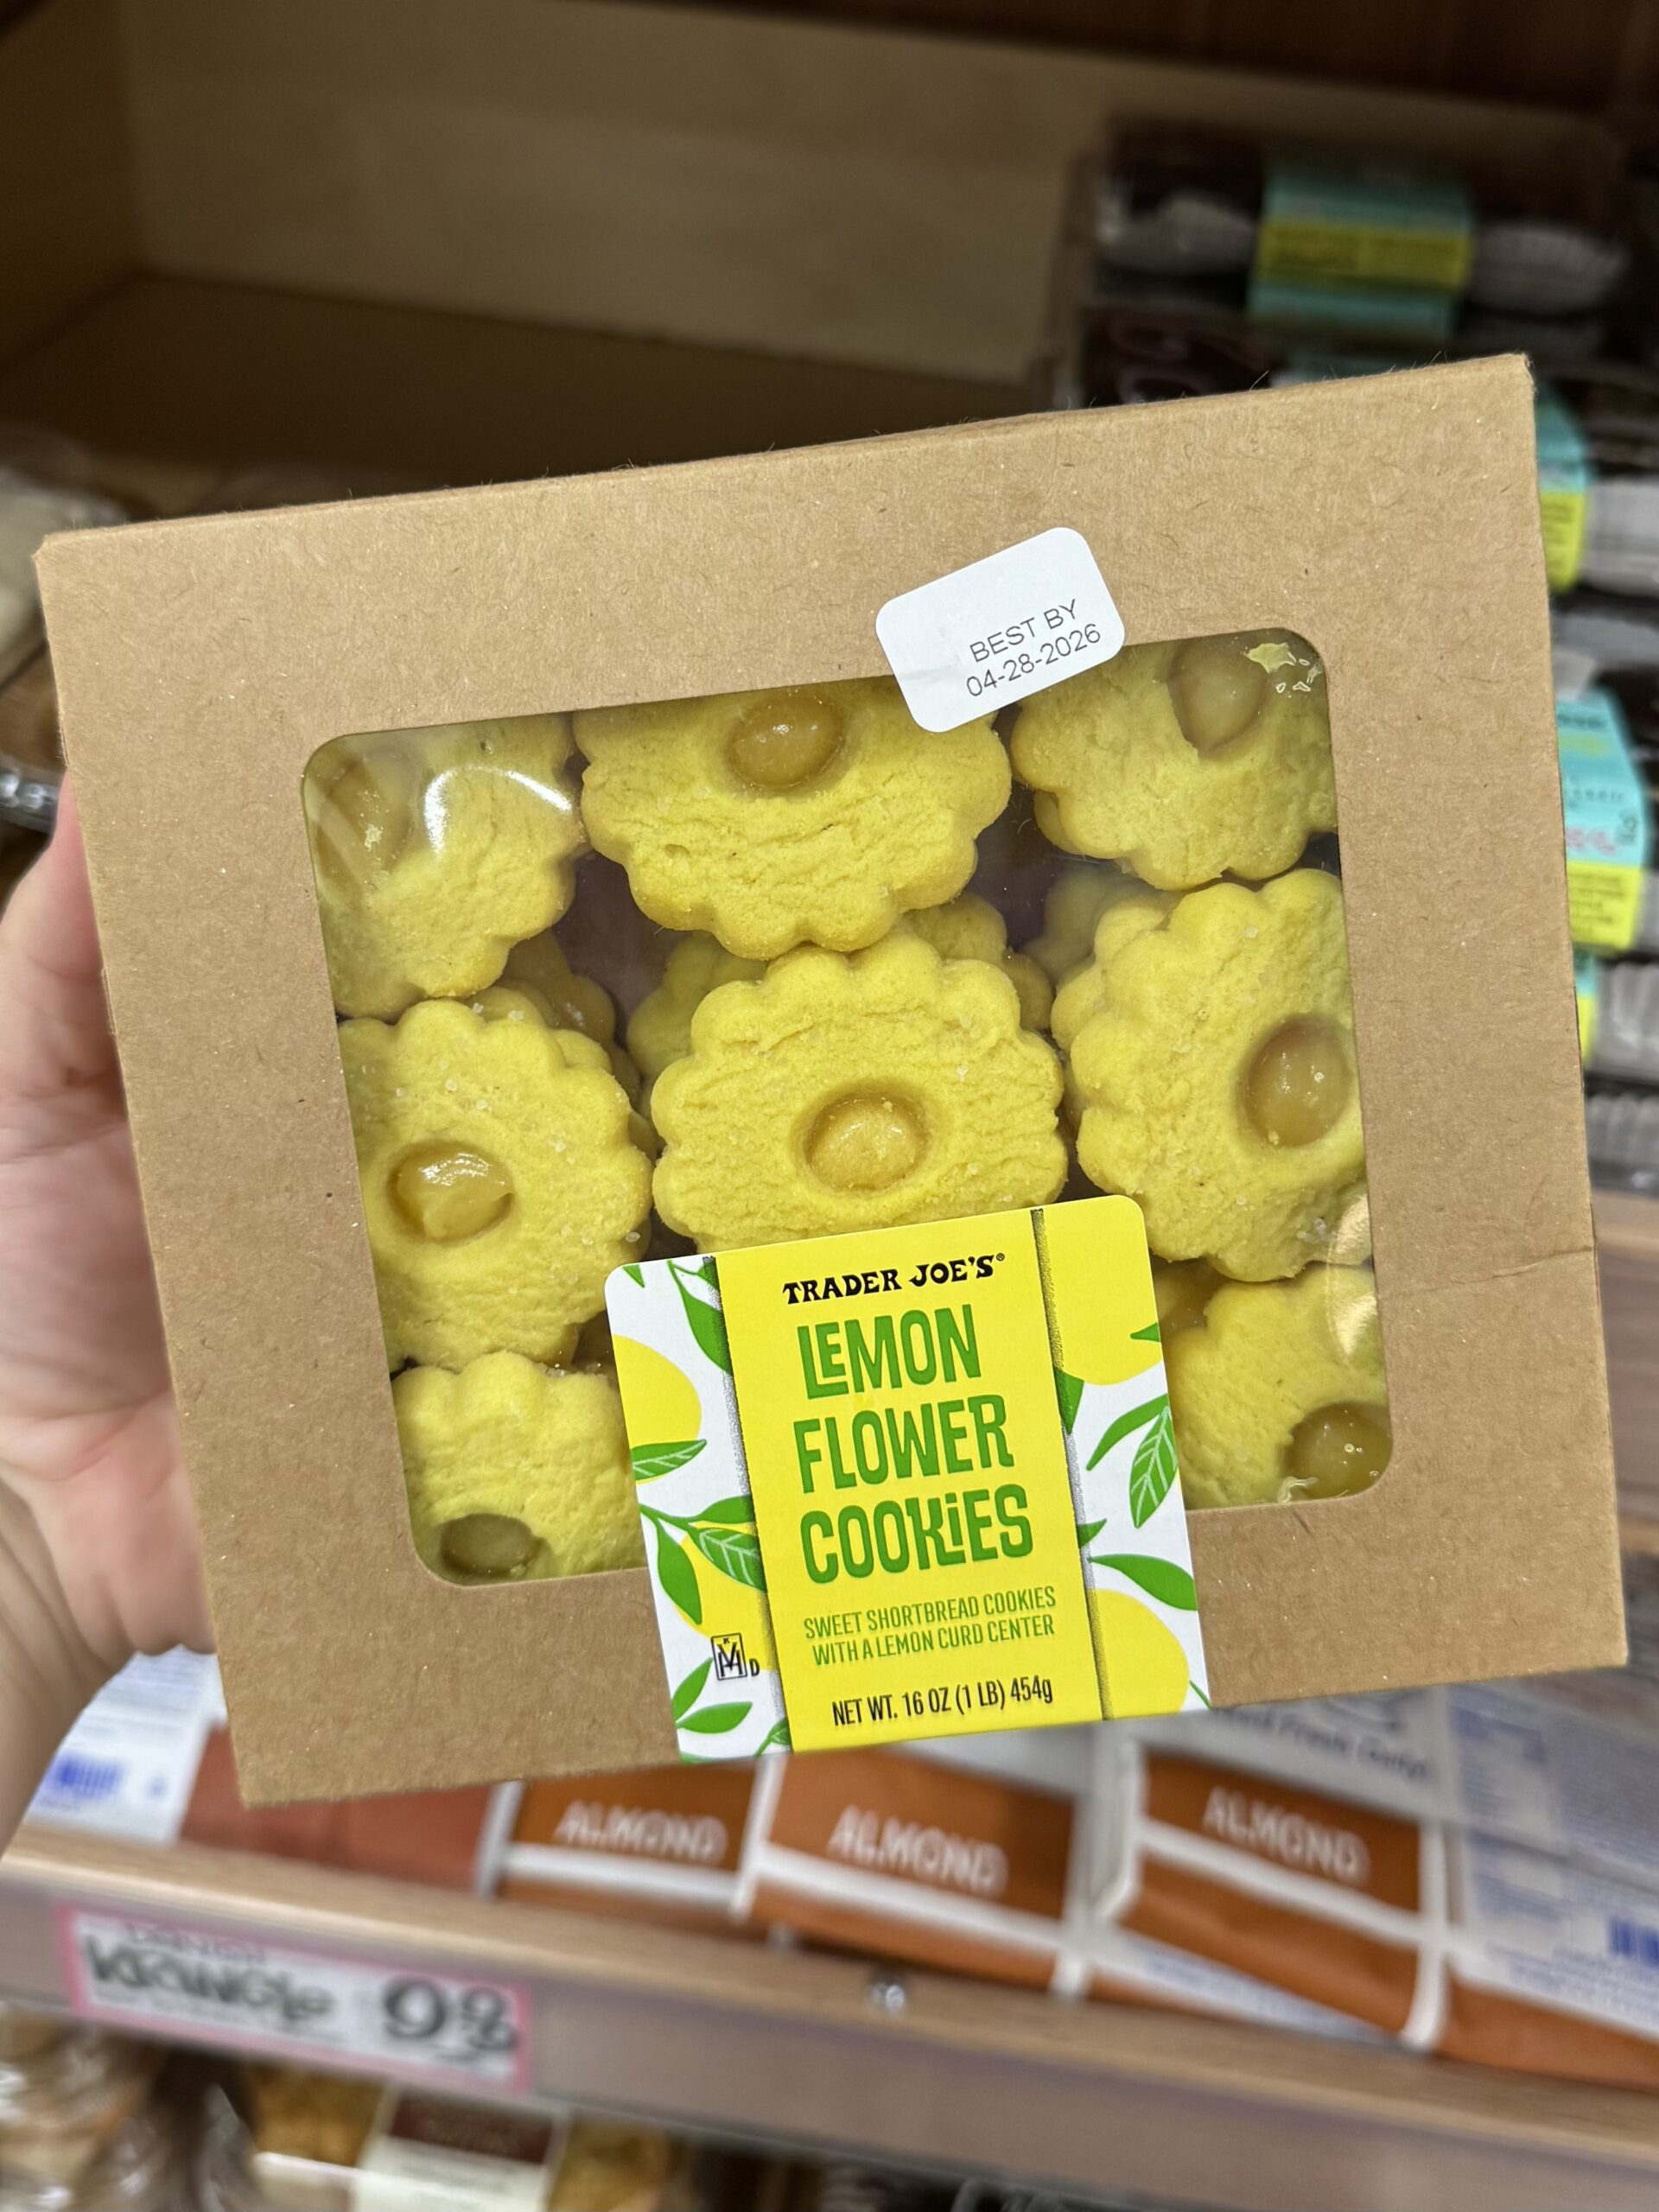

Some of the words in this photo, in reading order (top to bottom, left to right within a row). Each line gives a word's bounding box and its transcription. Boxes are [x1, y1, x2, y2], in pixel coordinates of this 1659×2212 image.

[966, 623, 1101, 696] 04-28-2026
[969, 617, 1036, 663] BEST
[1043, 598, 1078, 630] BY
[782, 1268, 902, 1305] TRADER
[797, 1303, 982, 1400] LEMON
[793, 1394, 1015, 1494] FLOWER
[804, 1611, 862, 1639] SWEET
[866, 1595, 980, 1631] SHORTBREAD
[982, 1586, 1057, 1617] COOKIES
[812, 1639, 859, 1666] WITH
[862, 1637, 874, 1660] A
[877, 1630, 935, 1658] LEMON
[938, 1623, 984, 1650] CURD
[987, 1613, 1055, 1643] CENTER
[831, 1698, 863, 1726] NET
[867, 1694, 898, 1722] WT.
[901, 1690, 925, 1717] 16
[928, 1687, 952, 1714] OZ
[955, 1684, 973, 1715] (1
[977, 1679, 1006, 1711] LB)
[1010, 1674, 1053, 1704] 454g
[553, 1800, 729, 1866] ALMOND
[827, 1804, 1009, 1898] ALMOND
[1202, 1786, 1372, 1888] ALMOND
